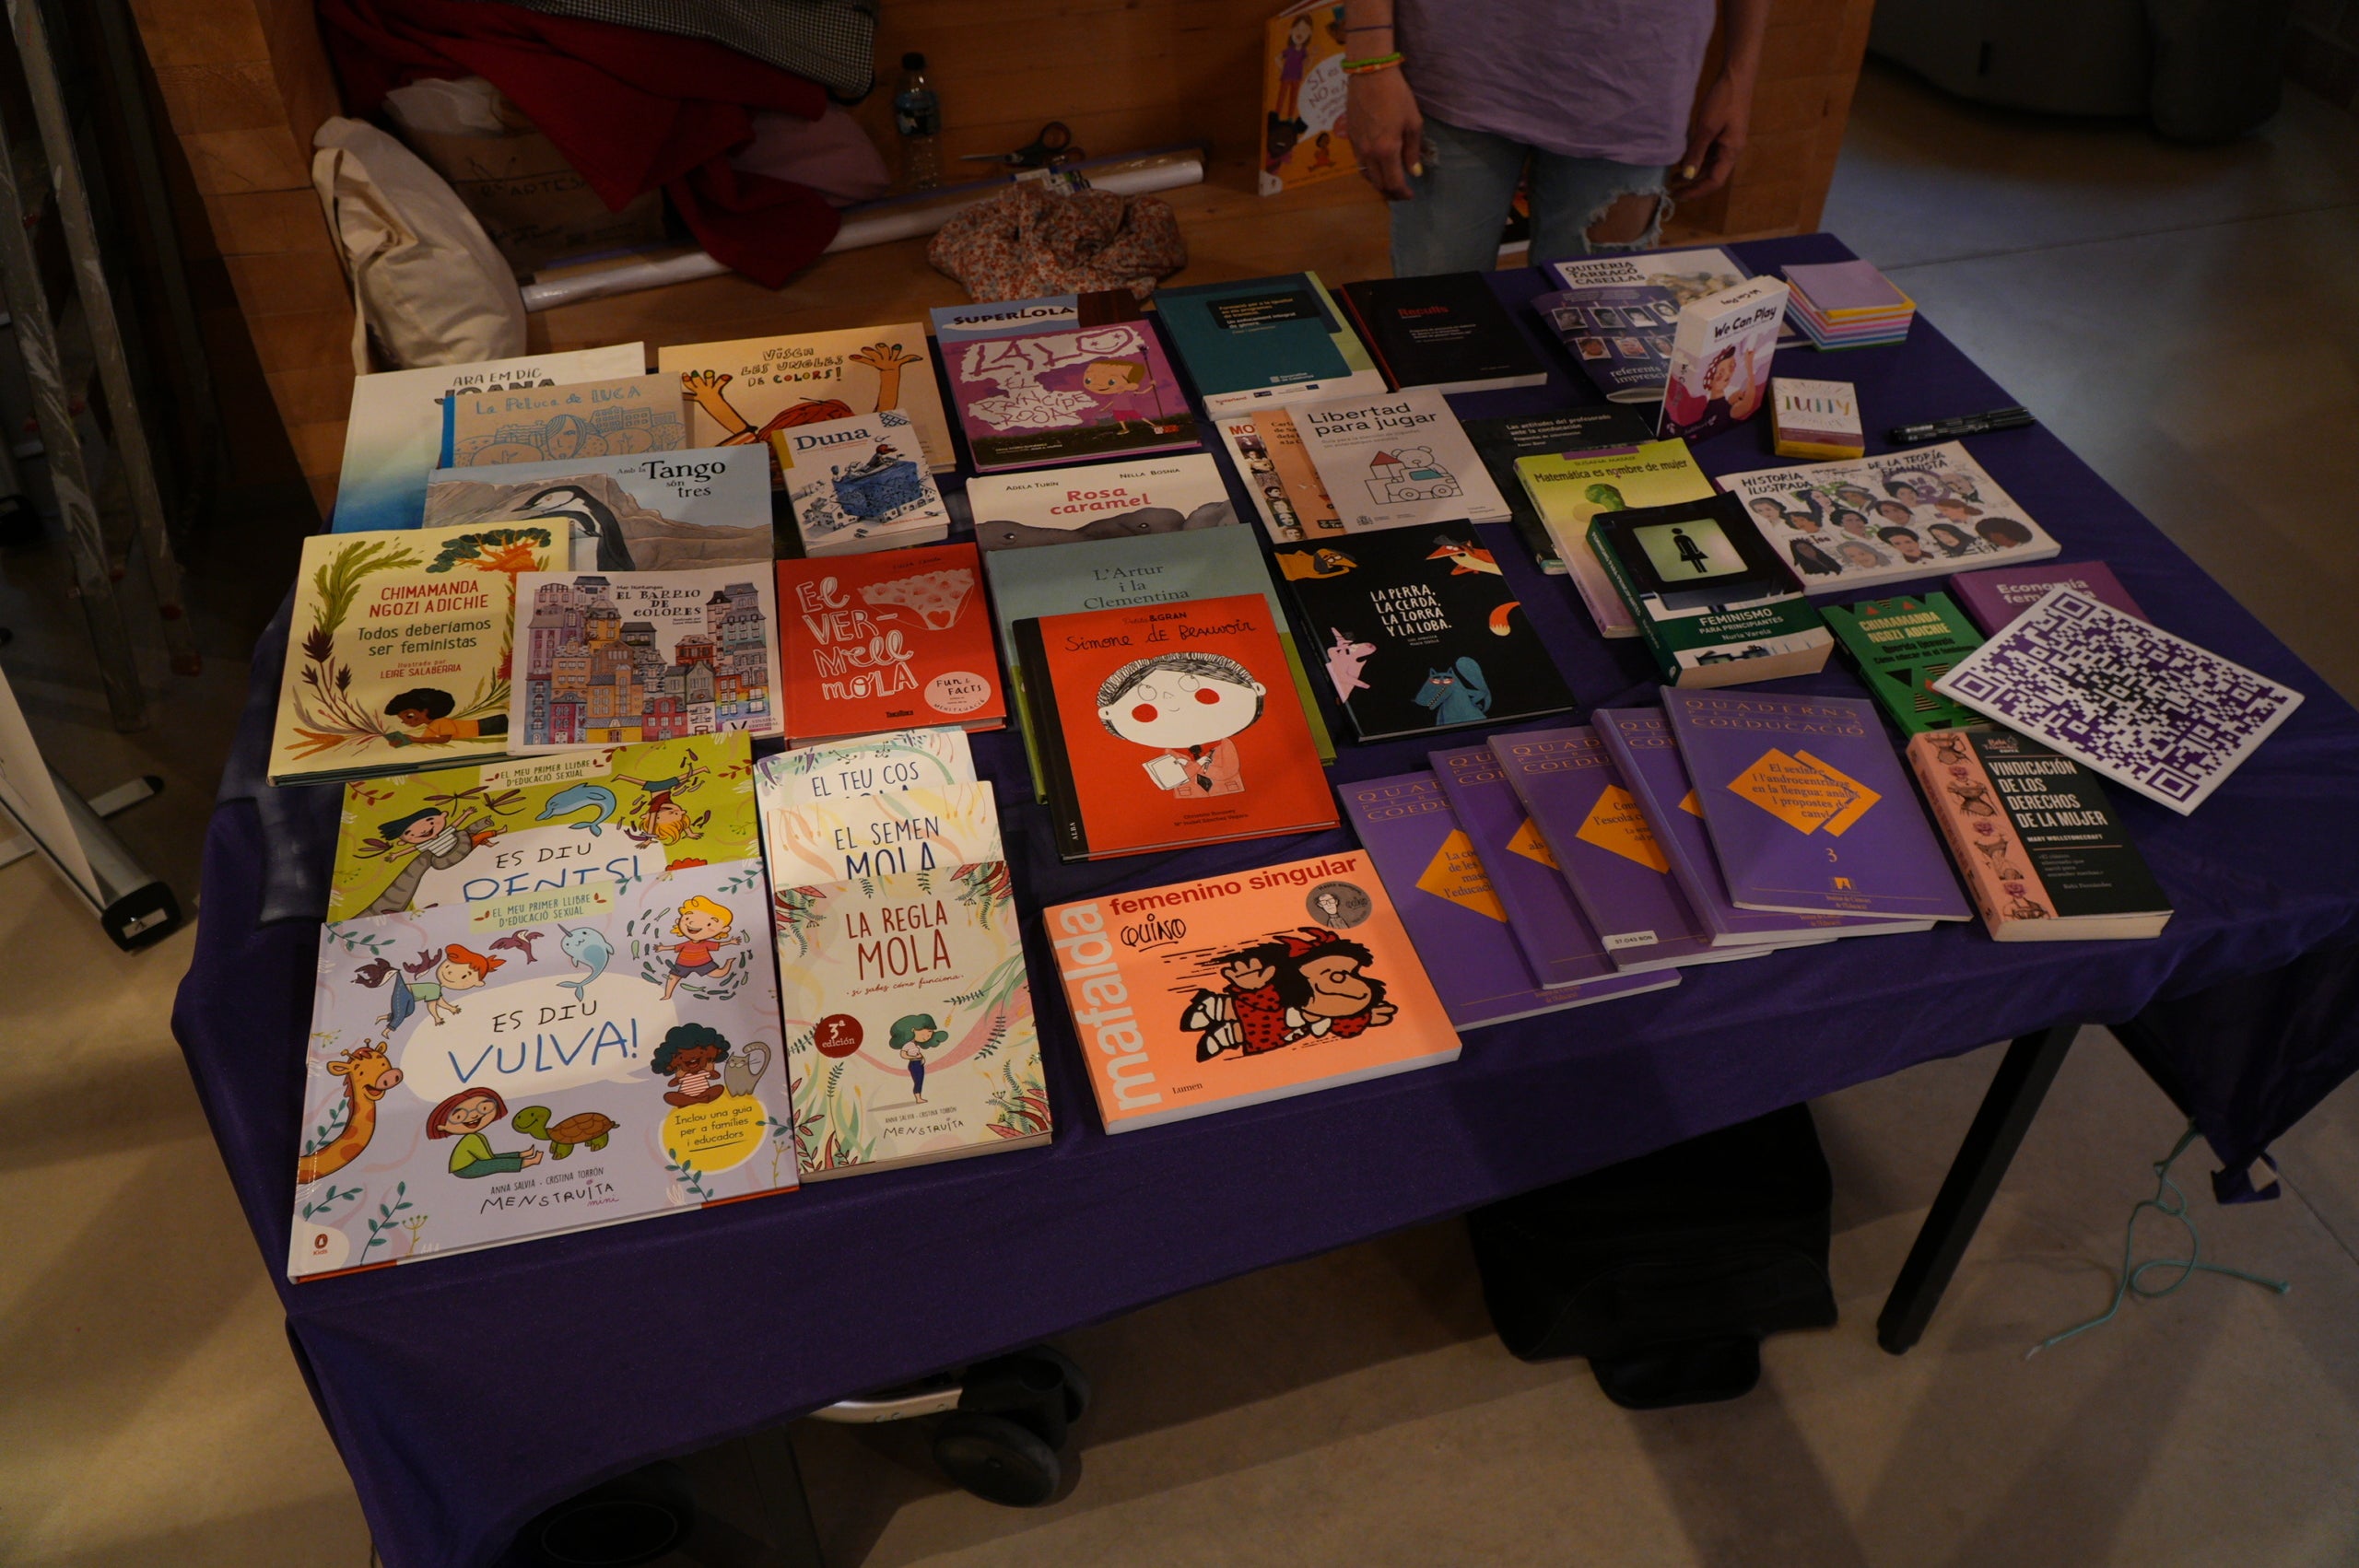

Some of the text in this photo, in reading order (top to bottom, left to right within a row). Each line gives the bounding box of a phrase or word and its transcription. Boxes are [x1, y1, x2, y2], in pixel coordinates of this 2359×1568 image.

[1714, 322, 1731, 338] We
[1731, 317, 1752, 331] Can
[1754, 307, 1778, 322] Play
[452, 373, 484, 387] ARA
[489, 372, 511, 383] EM
[1308, 403, 1411, 424] Libertad
[1314, 420, 1371, 438] para
[1374, 413, 1438, 431] jugar
[794, 427, 872, 451] Duna
[641, 461, 726, 483] Tango
[1533, 459, 1688, 483] Matemática es nombre de mujer
[665, 479, 685, 488] són
[678, 486, 712, 498] tres
[1066, 486, 1128, 502] Rosa
[1050, 493, 1152, 516] caramel
[1093, 565, 1166, 581] L'Artur
[381, 579, 479, 602] CHIMAMANDA
[616, 590, 701, 600] EL BARRIO
[795, 576, 851, 614] El
[1120, 580, 1147, 592] i la
[369, 594, 489, 619] NGOZI ADICHIE
[651, 600, 670, 609] DE
[1084, 589, 1191, 610] Clementina
[1370, 591, 1387, 603] LA
[632, 607, 702, 618] COLORES
[1375, 602, 1394, 614] LA
[1381, 607, 1445, 626] LA ZORRA
[1699, 608, 1774, 627] FEMINISMO
[358, 619, 492, 642] Todos deberíamos
[802, 609, 899, 646] VER-
[1386, 626, 1396, 637] Y
[1397, 625, 1416, 638] LA
[1698, 616, 1785, 635] PARA PRINCIPIANTES
[1744, 628, 1773, 638] Varela
[1858, 612, 1942, 634] CHIMAMANDA
[1867, 623, 1952, 643] NGOZI ADICHIE
[369, 637, 478, 657] ser feministas
[1064, 636, 1134, 652] Simone
[380, 669, 405, 680] LEIRE
[1684, 699, 1859, 720] QUADERNS
[1691, 718, 1866, 736] COEDUCACIÓ
[500, 760, 591, 779] EL MEU PRIMER LLIBRE
[1988, 757, 2079, 777] VINDICACIÓN
[507, 769, 583, 788] D'EDUCACIÓ SEXUAL
[812, 776, 832, 797] EL
[839, 768, 873, 791] TEU
[884, 761, 920, 785] COS
[1998, 778, 2048, 793] DE LOS
[1752, 786, 1766, 794] en
[1768, 785, 1778, 794] la
[1780, 798, 1834, 810] propostes
[2006, 794, 2082, 812] DERECHOS
[2016, 811, 2109, 828] DE LA MUJER
[835, 816, 940, 850] EL SEMEN
[496, 843, 592, 869] ES DIU
[1825, 848, 1838, 863] 3
[1109, 857, 1358, 916] femenino singular
[492, 894, 591, 919] EL MEU PRIMER LLIBRE
[499, 905, 584, 929] D'EDUCACIÓ SEXUAL
[845, 899, 948, 939] LA REGLA
[1121, 913, 1187, 949] QUINO
[858, 928, 951, 981] MOLA
[492, 1000, 599, 1033] ES DIU
[1056, 902, 1164, 1112] mafalda
[448, 1017, 640, 1084] VULVA!
[821, 1036, 856, 1048] edición
[1172, 1081, 1203, 1095] Lumen
[675, 1106, 753, 1126] Inclou una guia
[680, 1127, 697, 1139] per
[710, 1117, 750, 1130] famílies
[883, 1118, 965, 1140] MENSTRUITA
[687, 1131, 745, 1147] i educadors
[490, 1185, 511, 1196] ANNA
[514, 1179, 536, 1191] SALVIA
[546, 1173, 574, 1186] CRISTINA
[480, 1180, 615, 1214] MENSTRUITA
